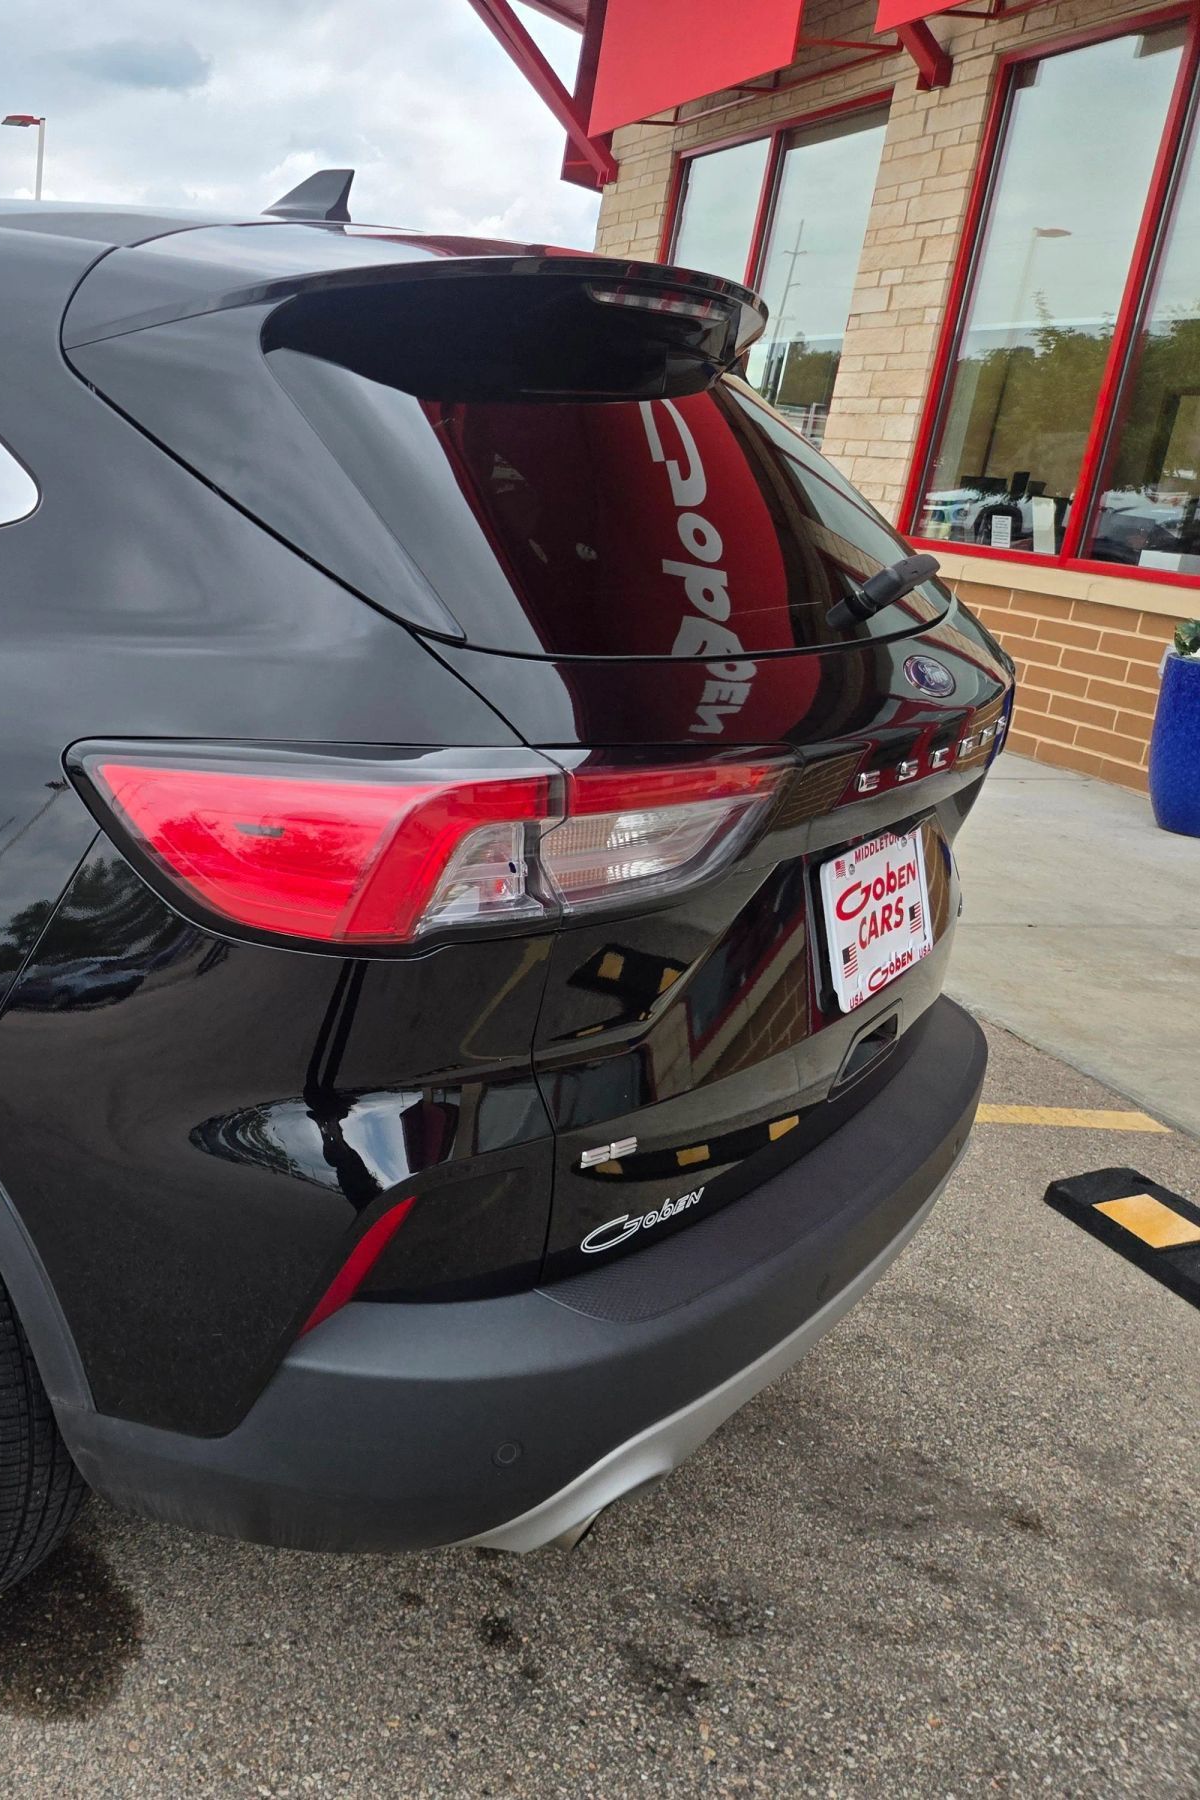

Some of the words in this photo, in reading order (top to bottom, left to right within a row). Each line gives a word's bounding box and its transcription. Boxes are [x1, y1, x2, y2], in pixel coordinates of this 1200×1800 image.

[859, 896, 904, 950] CARS
[849, 991, 864, 1008] USA
[580, 1136, 638, 1169] SE
